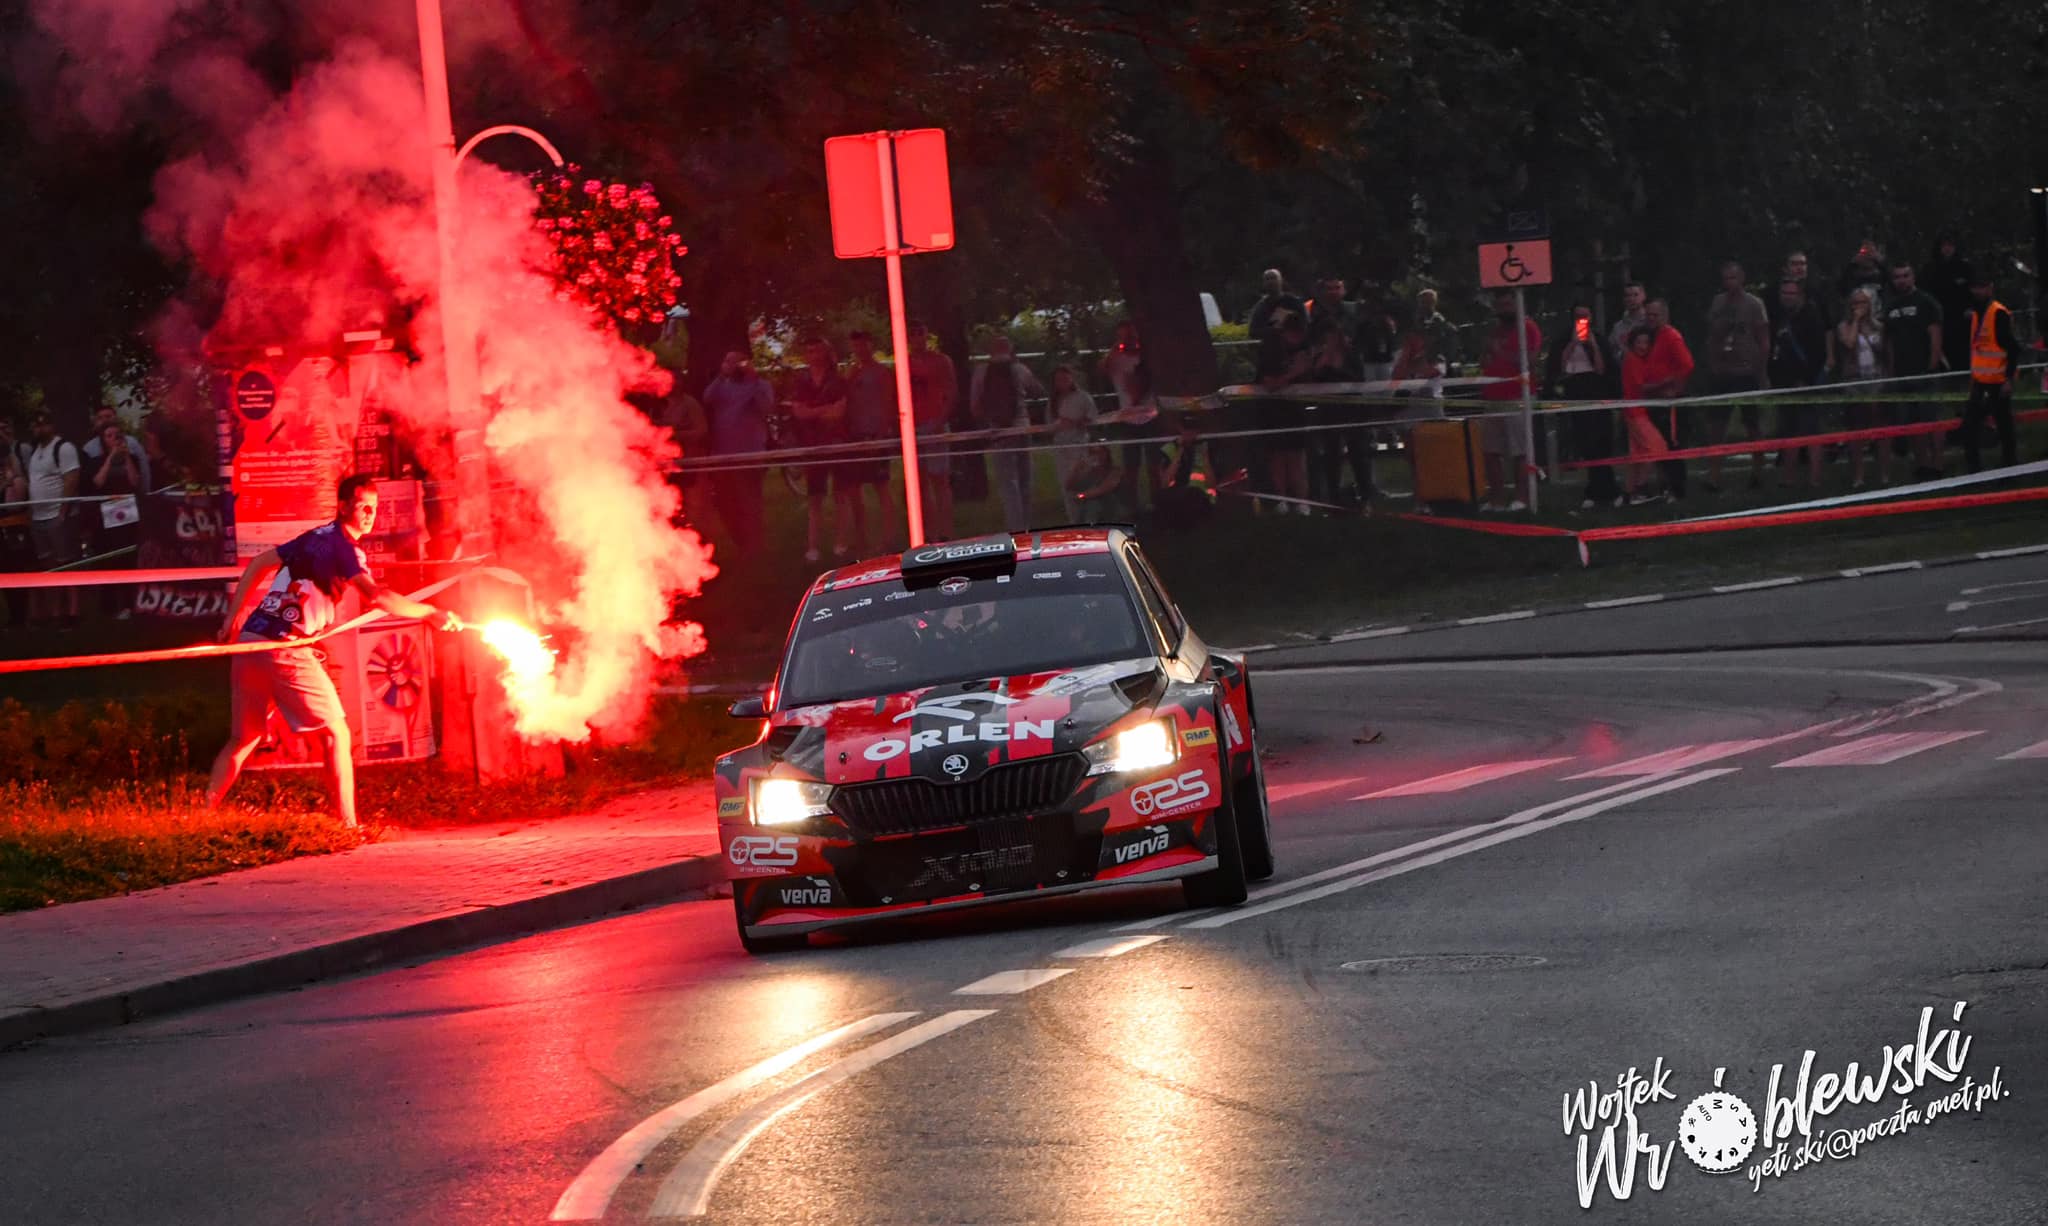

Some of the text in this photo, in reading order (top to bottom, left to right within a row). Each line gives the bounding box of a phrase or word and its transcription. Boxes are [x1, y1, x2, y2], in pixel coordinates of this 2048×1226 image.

[863, 719, 1055, 762] ORLEN
[1185, 729, 1210, 742] RMF
[719, 802, 745, 814] RMF
[1114, 830, 1169, 865] verva
[781, 888, 832, 905] verva
